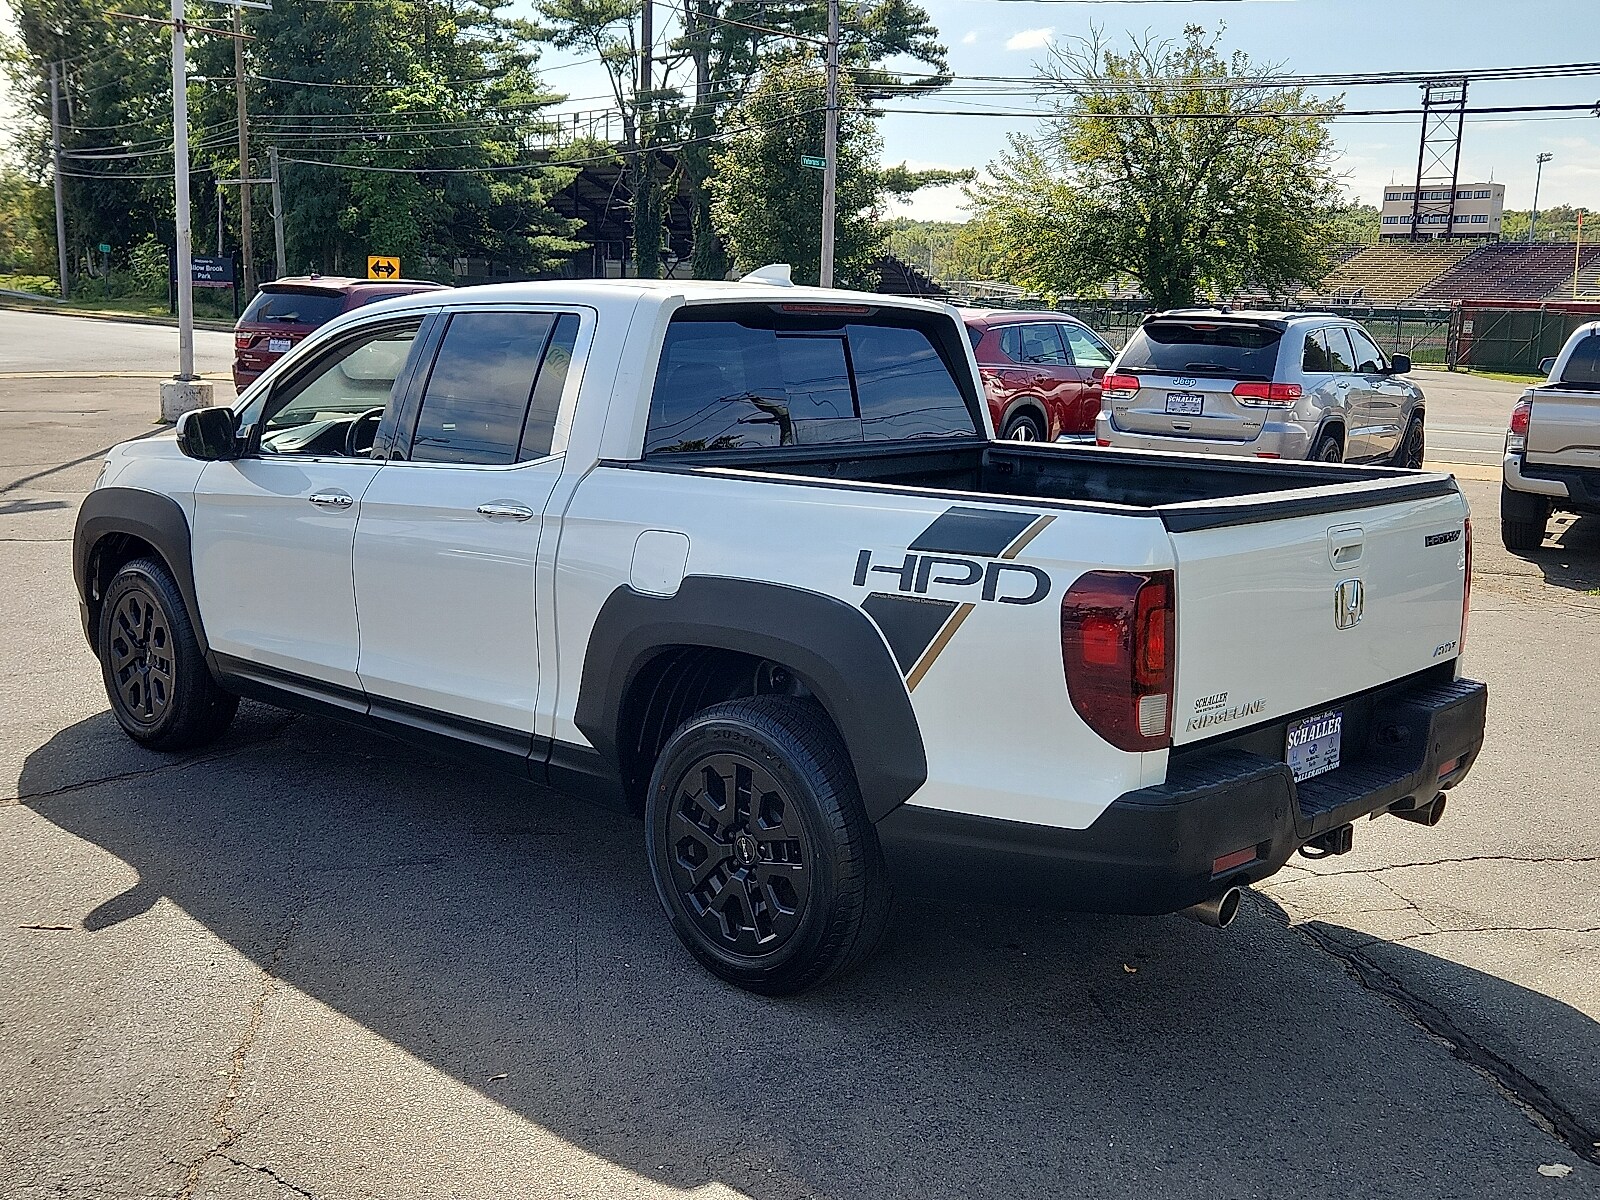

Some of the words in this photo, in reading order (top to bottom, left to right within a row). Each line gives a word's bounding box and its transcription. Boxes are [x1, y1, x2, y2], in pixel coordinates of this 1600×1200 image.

[205, 264, 223, 272] Brook
[1173, 377, 1197, 387] Jeep
[1168, 396, 1202, 404] SCHALLER
[853, 549, 1052, 605] HPD
[1194, 691, 1228, 710] SCHALLER
[1185, 698, 1267, 733] RIDGELINE
[1287, 716, 1342, 750] SCHALLER
